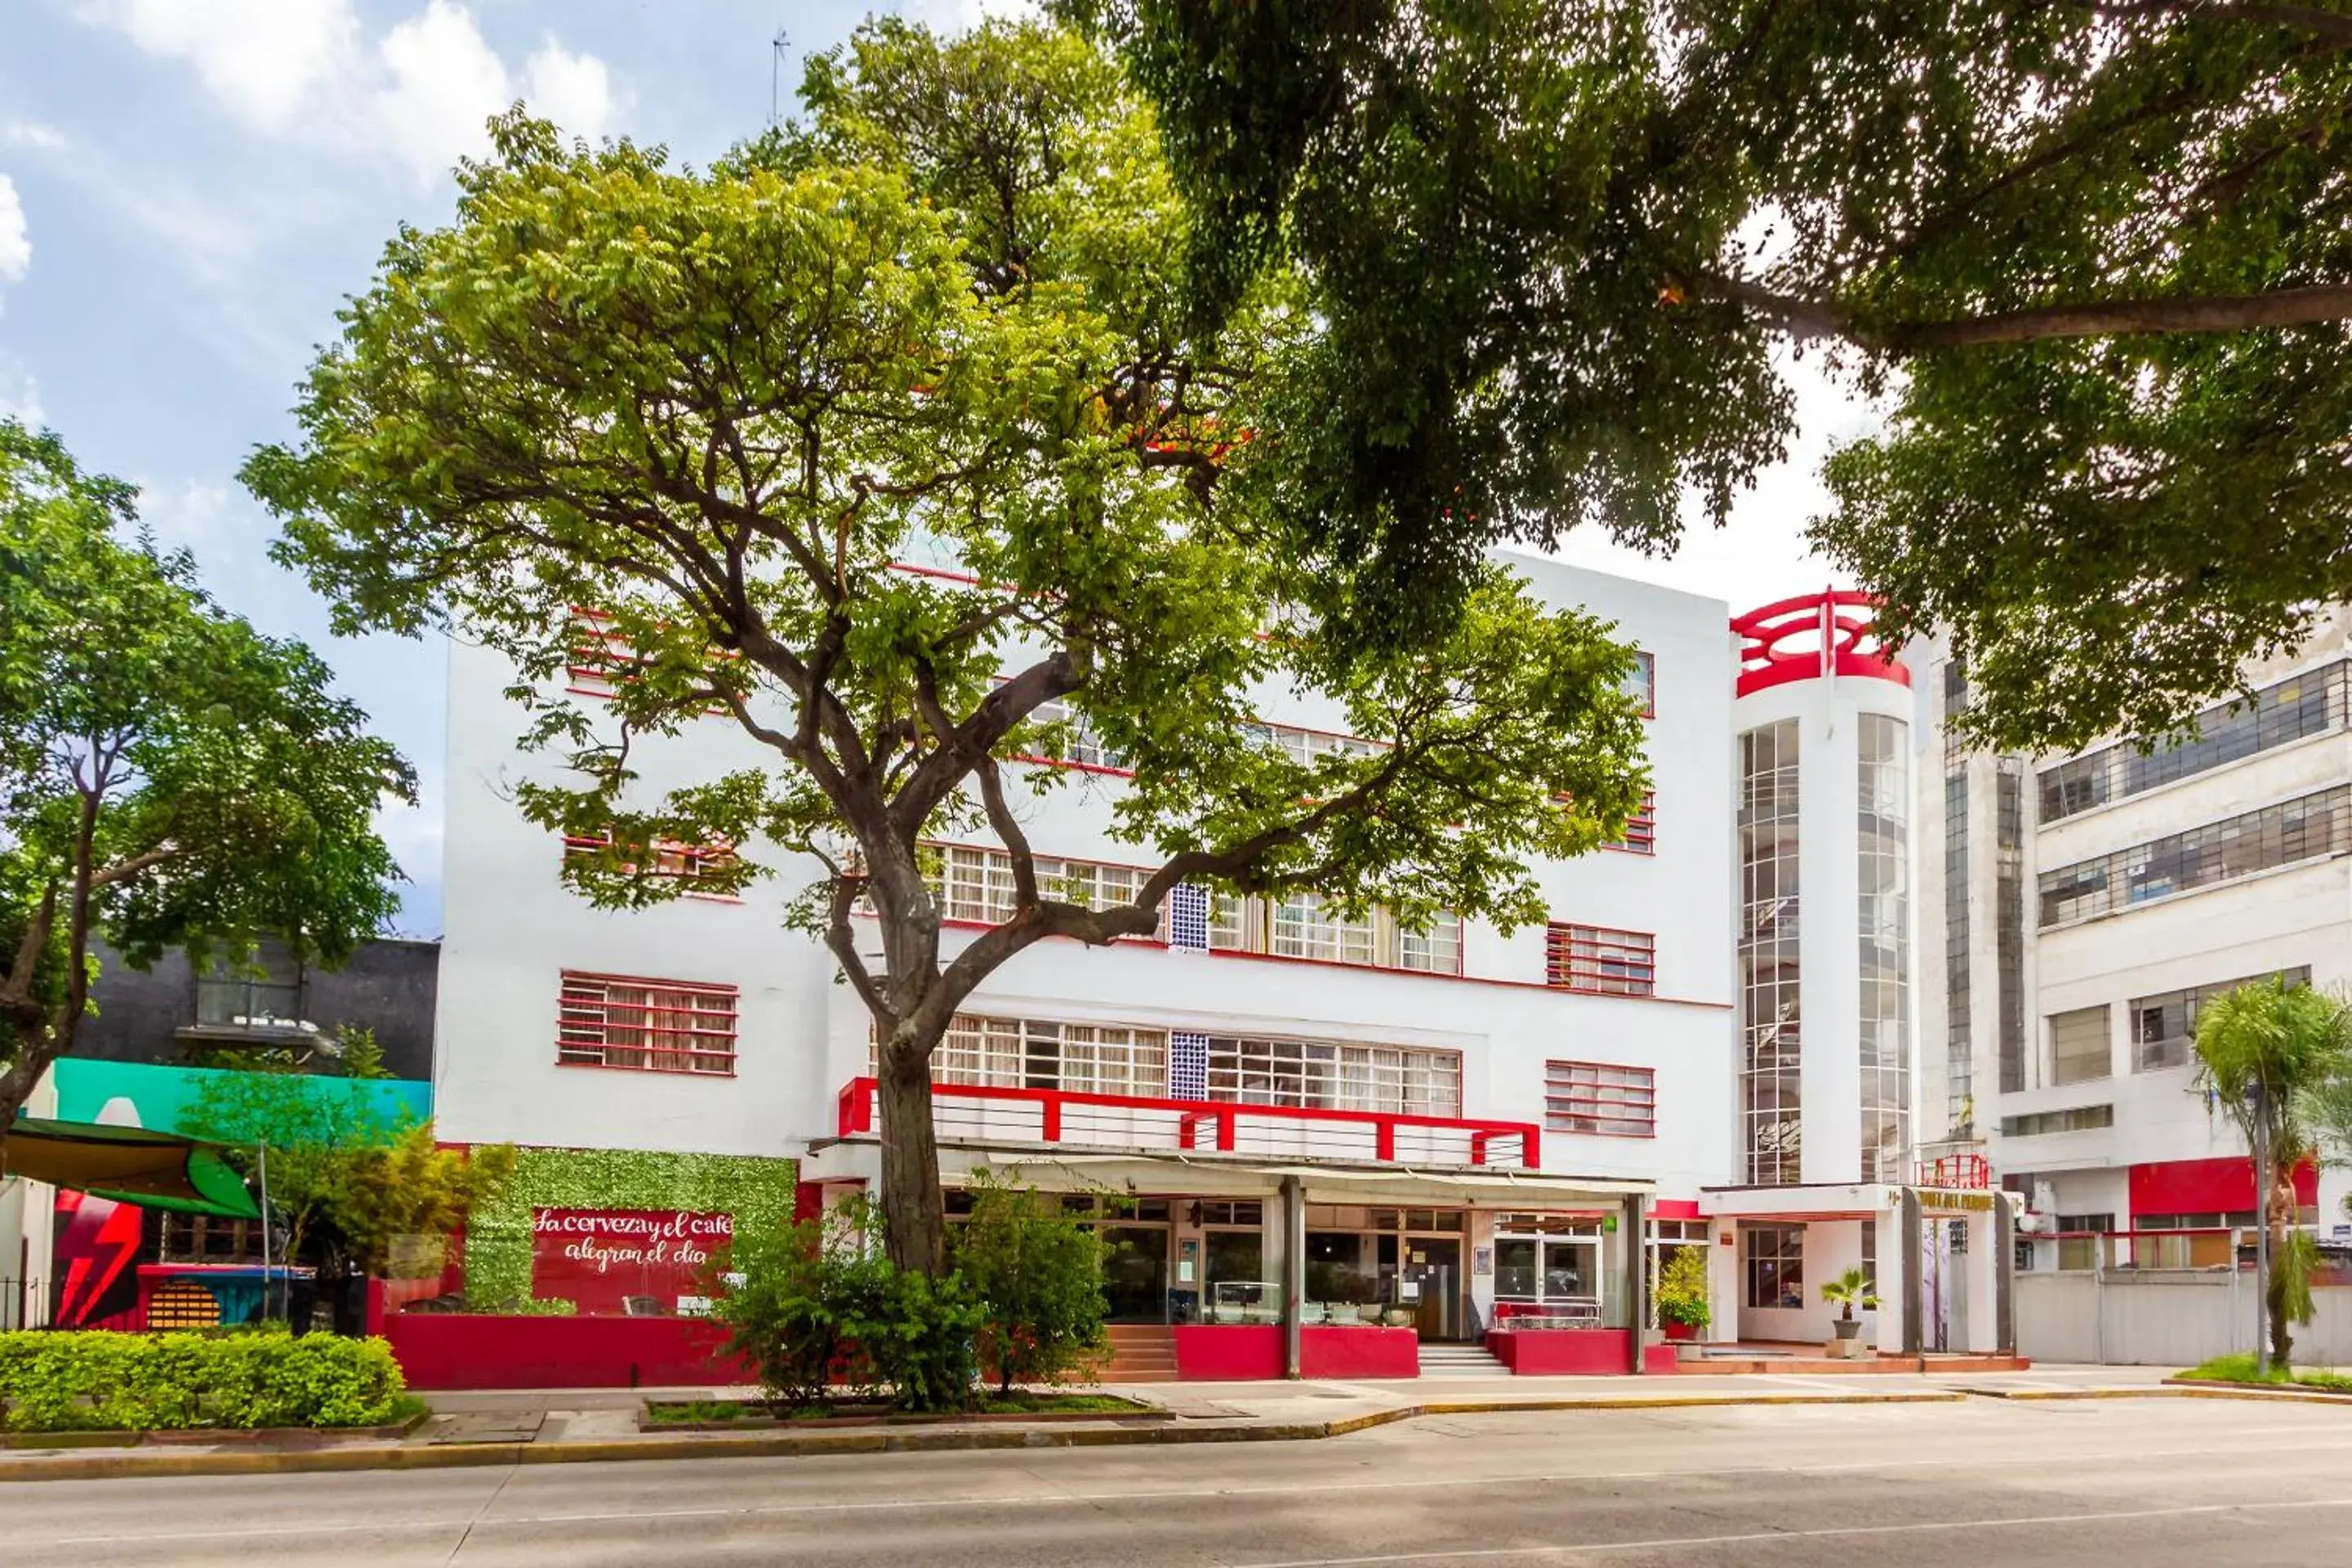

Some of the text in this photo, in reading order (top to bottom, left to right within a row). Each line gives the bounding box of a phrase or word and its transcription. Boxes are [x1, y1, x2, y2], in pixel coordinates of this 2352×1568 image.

[564, 1216, 648, 1233] cerveza
[648, 1219, 662, 1242] y
[663, 1213, 688, 1238] el
[565, 1236, 643, 1272] alegran
[646, 1241, 669, 1263] el
